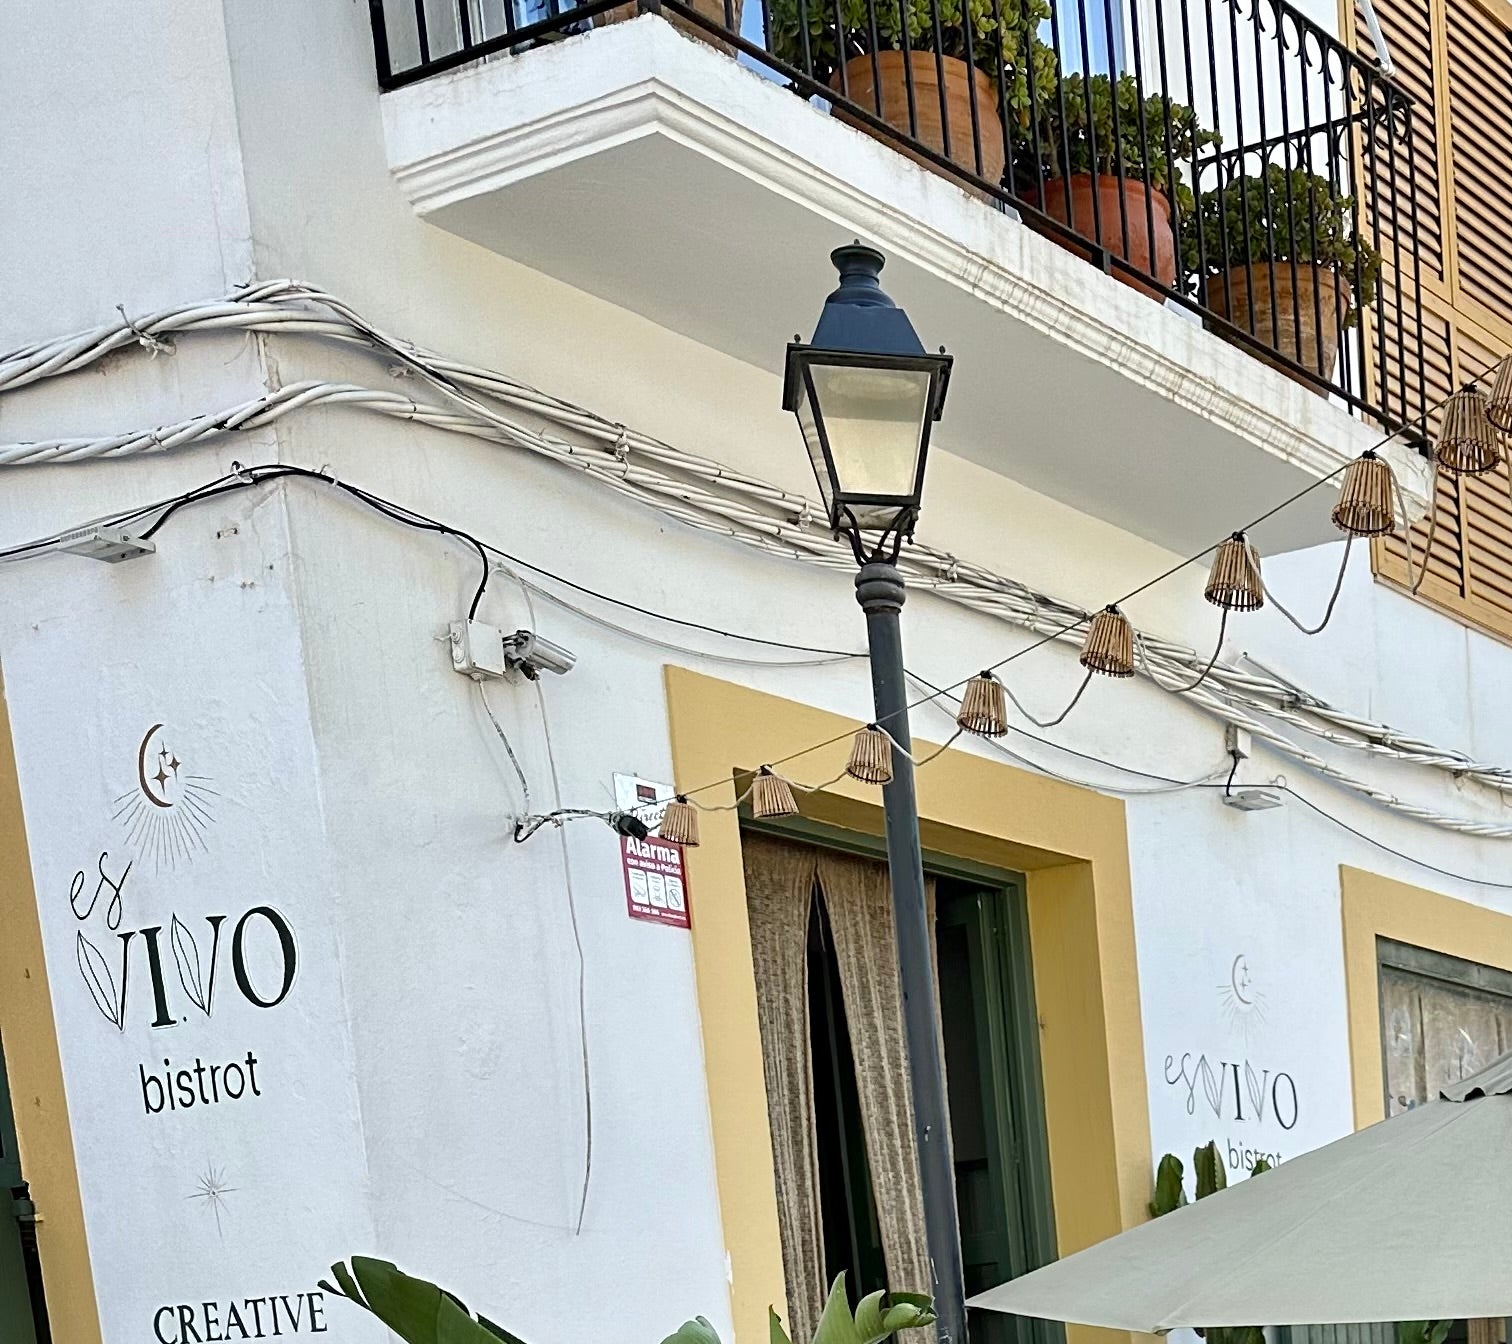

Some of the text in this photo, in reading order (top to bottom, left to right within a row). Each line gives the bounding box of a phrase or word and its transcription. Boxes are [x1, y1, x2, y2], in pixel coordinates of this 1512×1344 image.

[626, 836, 681, 865] Alarma
[69, 851, 133, 931] es
[76, 905, 300, 1032] VIVO
[139, 1051, 263, 1115] bistrot
[1164, 1052, 1298, 1130] es VIVO
